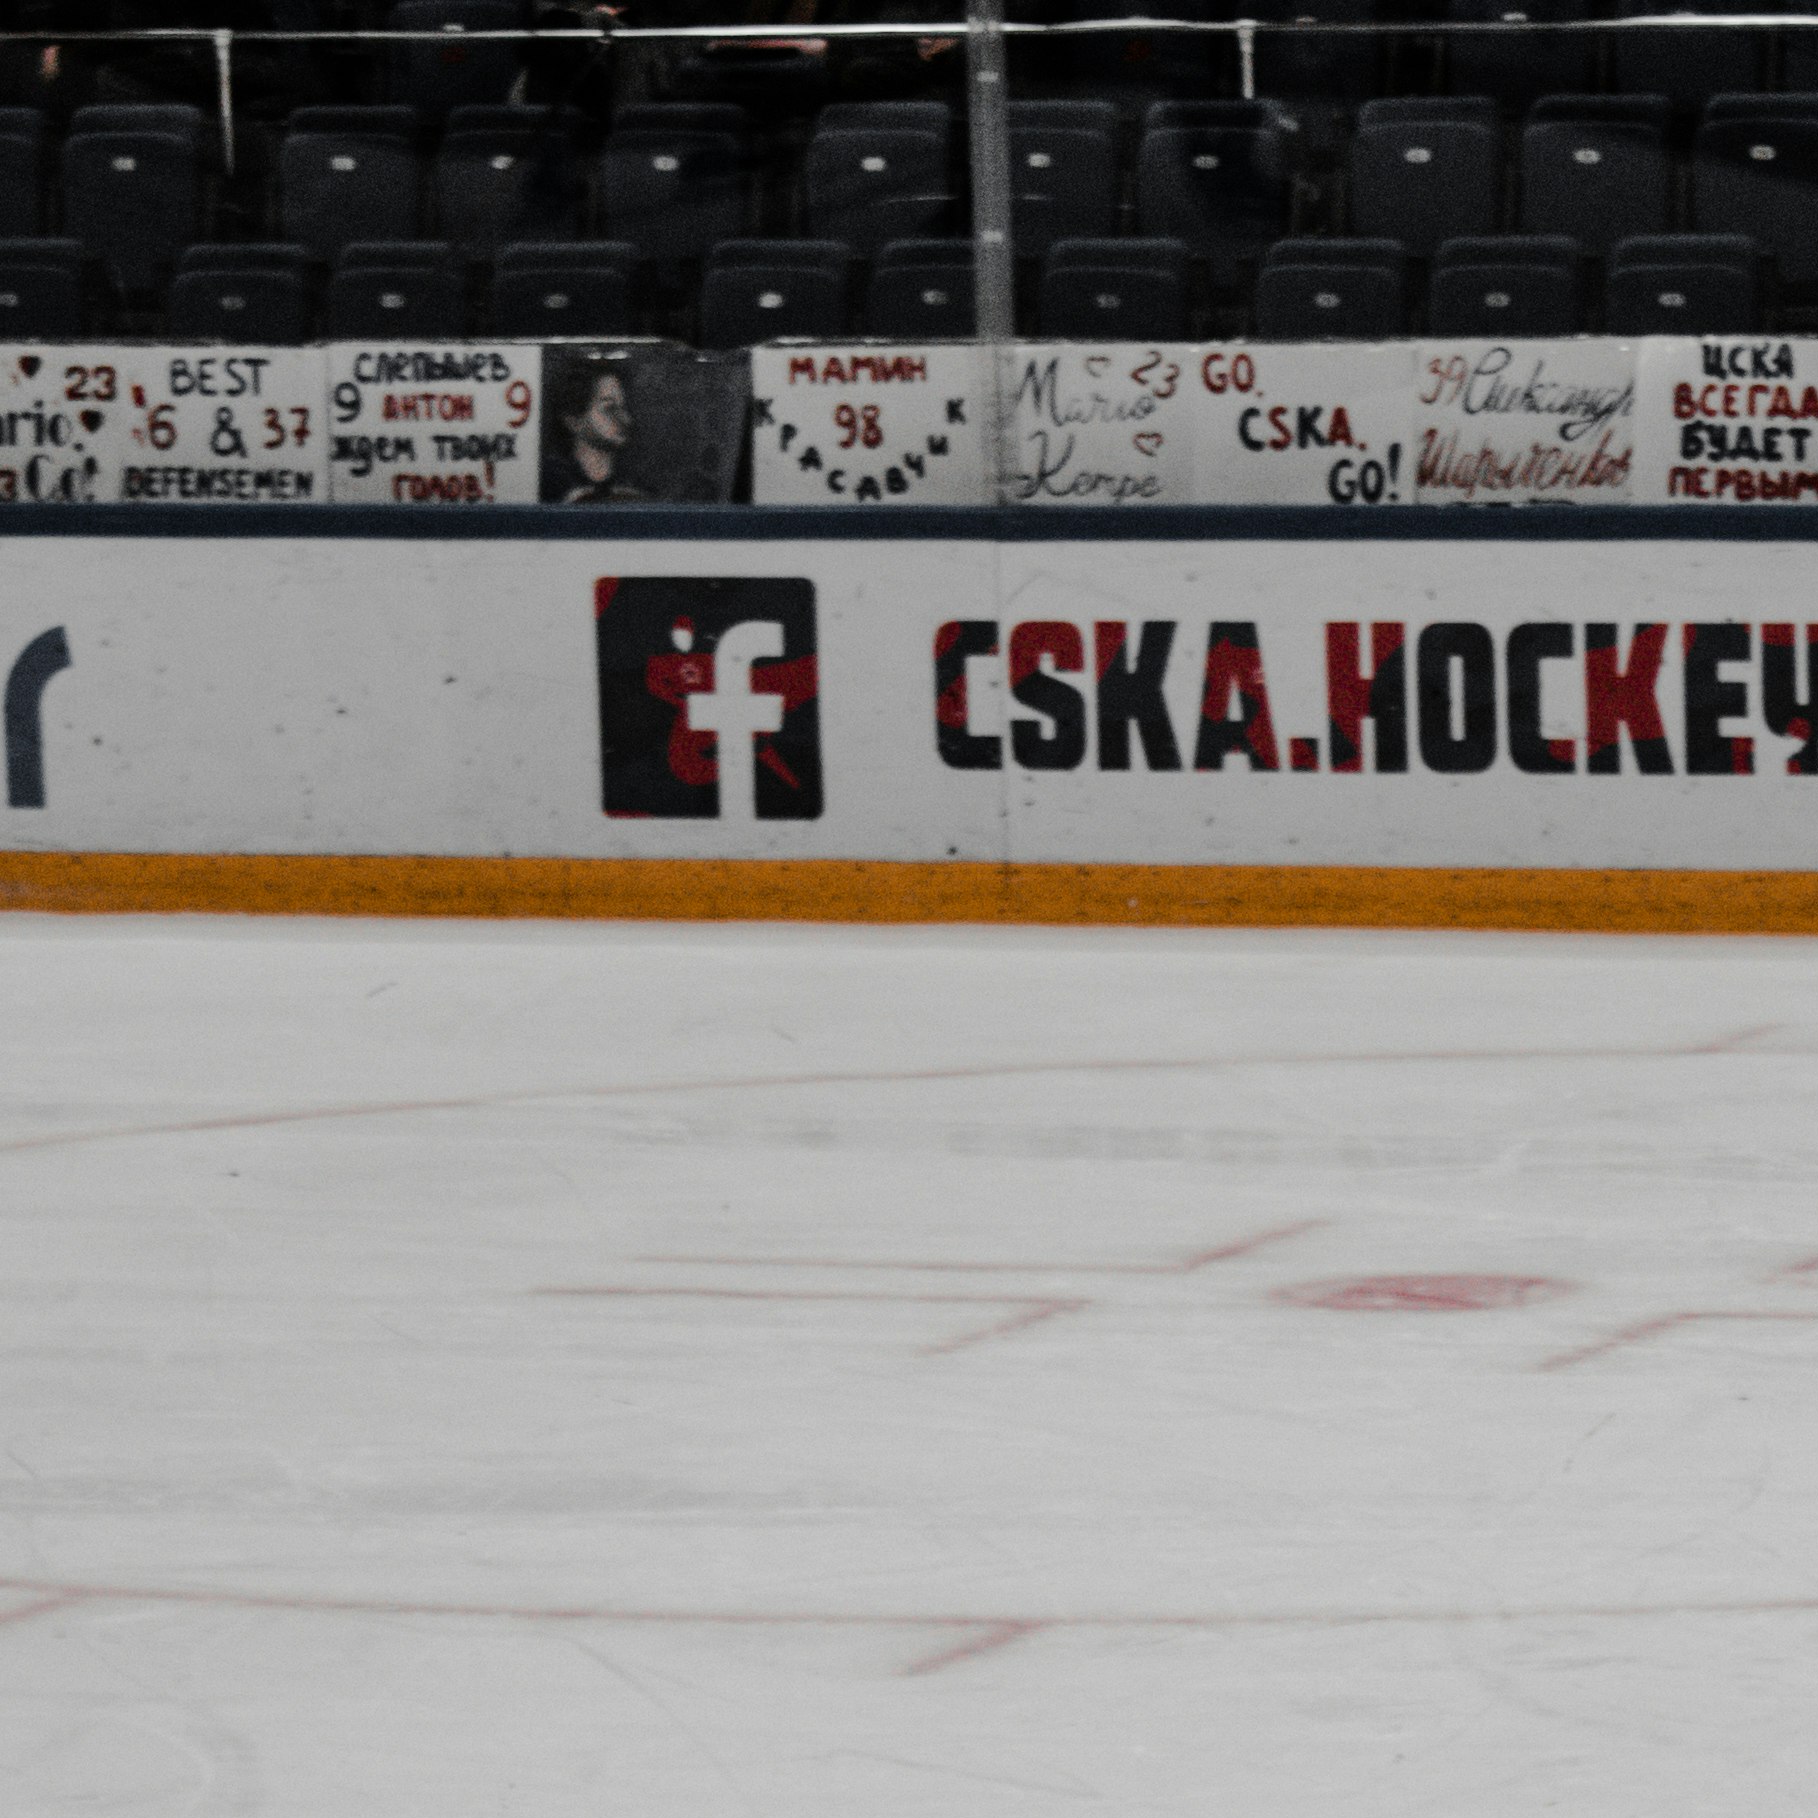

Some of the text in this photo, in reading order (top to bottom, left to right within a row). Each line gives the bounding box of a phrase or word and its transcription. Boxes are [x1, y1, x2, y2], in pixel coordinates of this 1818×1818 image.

[65, 366, 117, 401] 23
[169, 358, 270, 396] BEST
[1130, 350, 1181, 399] 23
[1702, 343, 1794, 380] ЦСКА
[147, 404, 178, 450] 6
[263, 406, 311, 449] 37
[334, 382, 362, 423] 9
[505, 381, 532, 428] 9
[834, 403, 884, 449] 98
[1680, 421, 1812, 462] БУДЕТ
[1328, 443, 1401, 505] GO!
